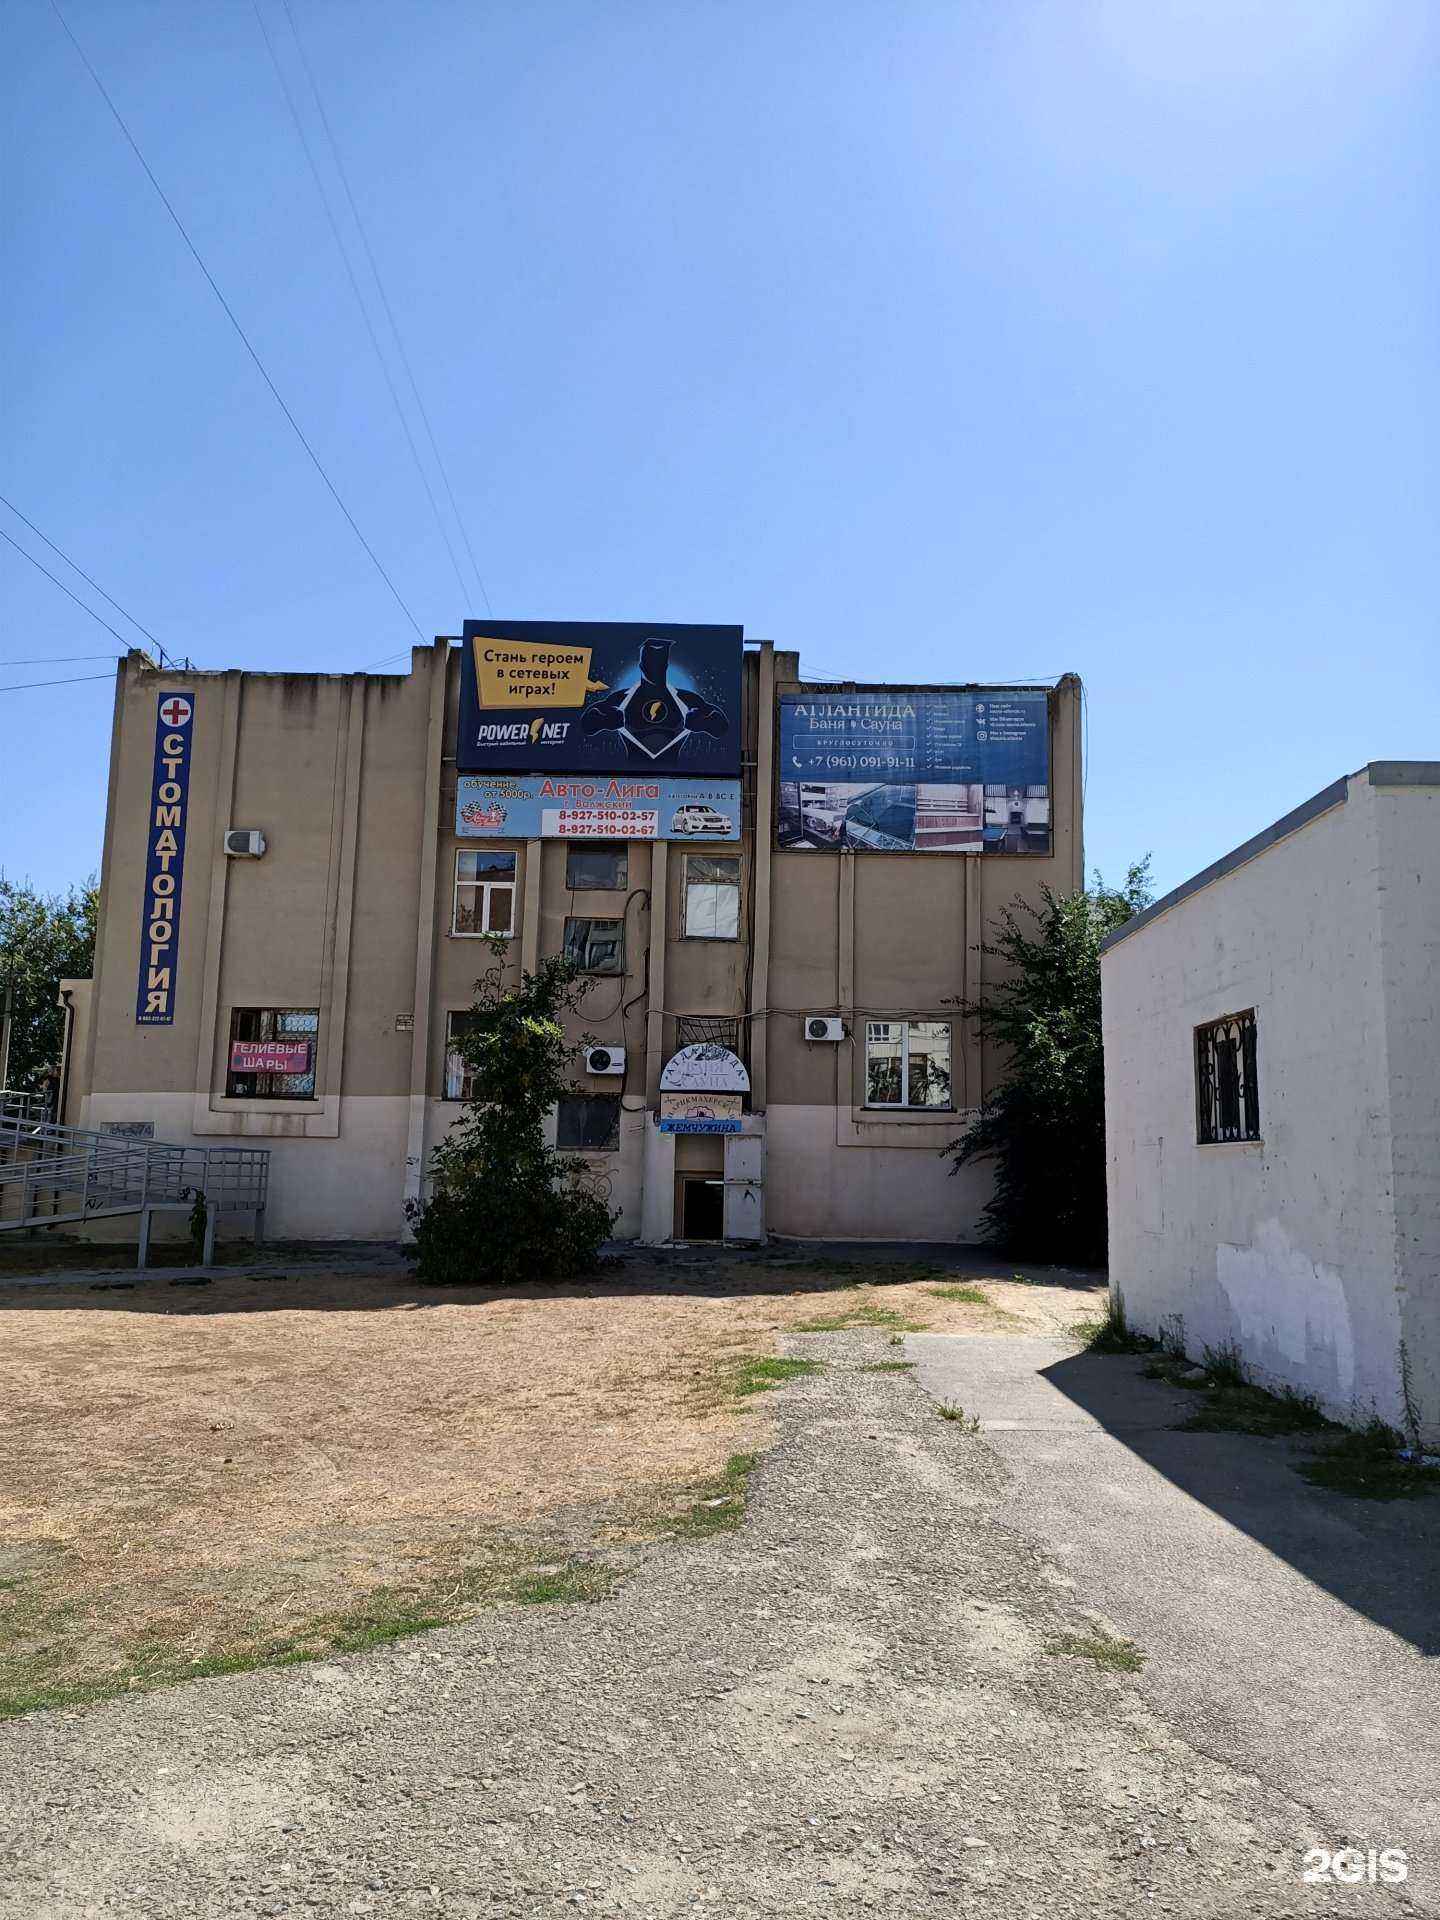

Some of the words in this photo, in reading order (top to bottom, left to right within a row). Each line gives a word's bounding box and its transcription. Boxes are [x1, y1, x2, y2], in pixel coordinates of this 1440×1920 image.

[484, 649, 527, 663] Стань
[531, 654, 584, 667] героем
[496, 669, 505, 678] в
[509, 669, 570, 680] сетевых
[508, 682, 556, 698] играх!
[478, 724, 530, 740] POWER
[541, 722, 571, 739] NET
[809, 717, 845, 729] Баня
[860, 719, 903, 732] Сауна
[808, 756, 824, 767] +7
[826, 755, 857, 768] (961)
[860, 756, 915, 768] 091-91-11
[540, 780, 659, 798] Авто-Лига
[575, 800, 632, 809] Волжский
[559, 811, 655, 820] 8-927-510-02-57
[558, 825, 655, 834] 8-927-510-02-67
[144, 733, 185, 1013] СТОМАТОЛОГИЯ
[233, 1042, 307, 1054] ГЕЛИЕВЫЕ
[243, 1057, 287, 1070] ШАРЫ
